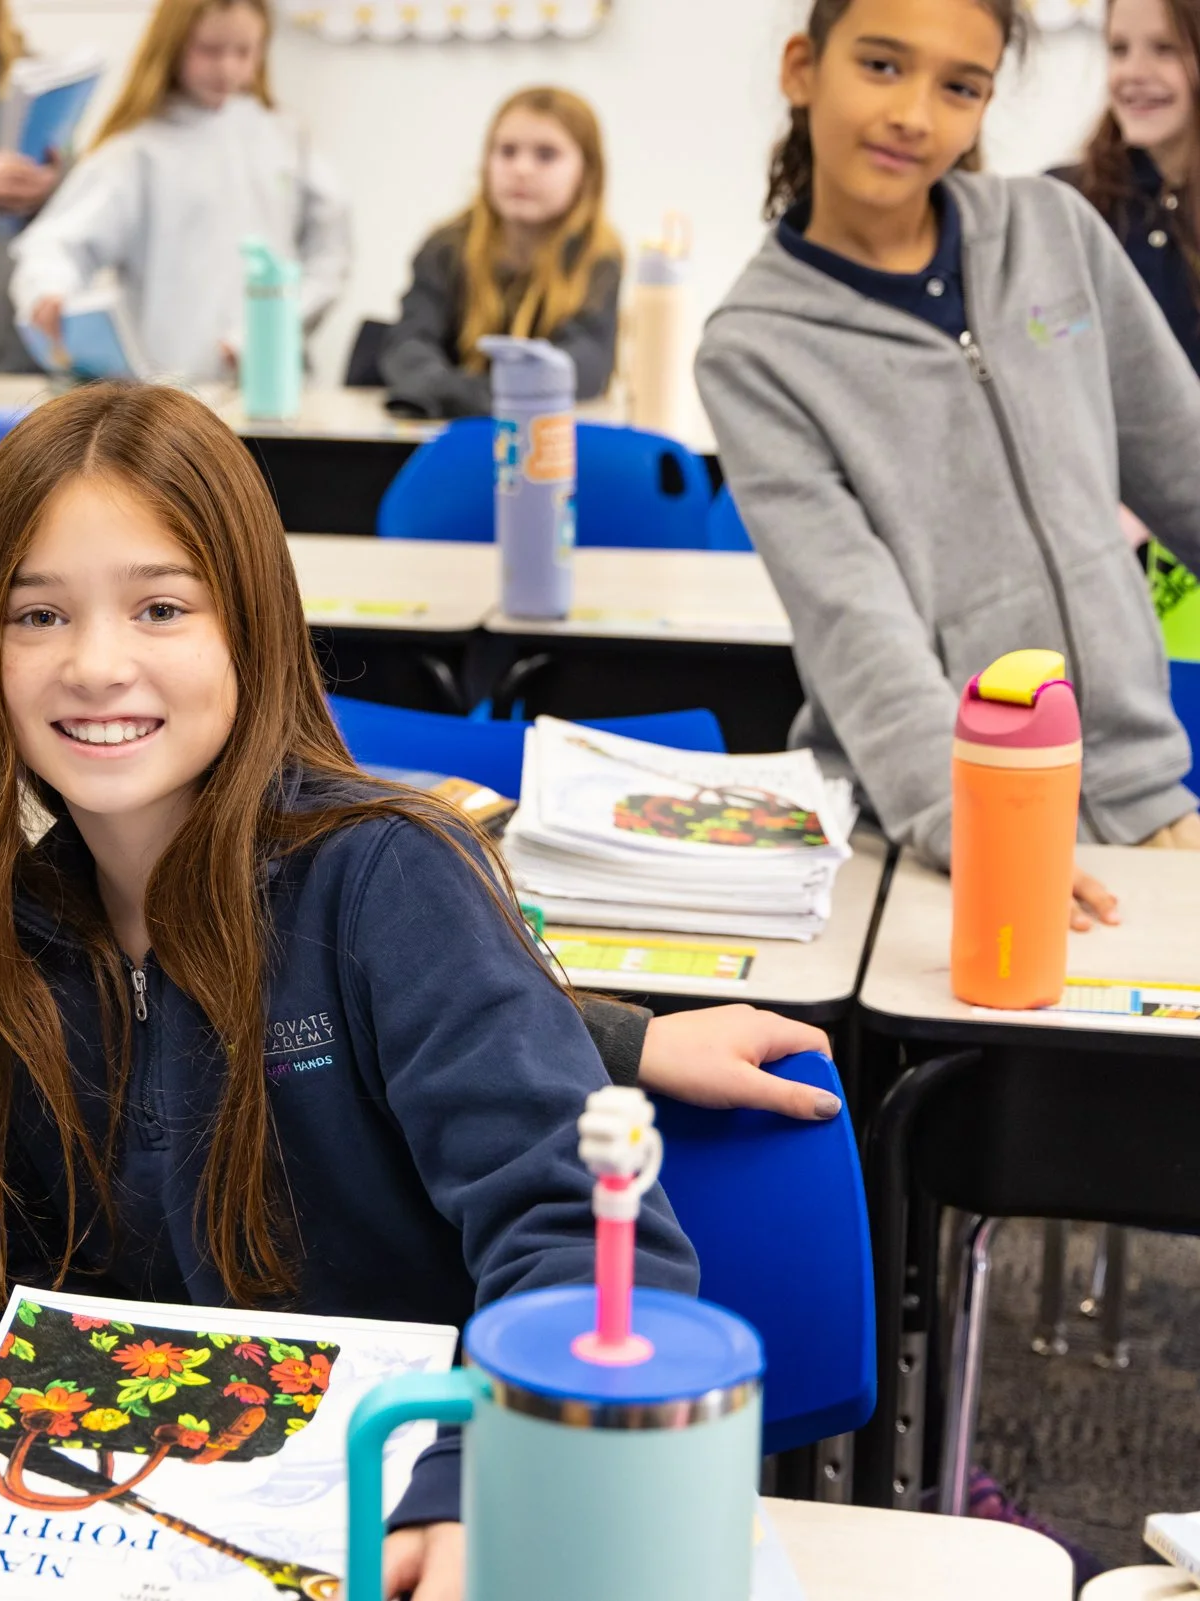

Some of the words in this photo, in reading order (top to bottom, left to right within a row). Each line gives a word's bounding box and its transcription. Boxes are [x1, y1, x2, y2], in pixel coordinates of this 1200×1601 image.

[264, 1012, 331, 1037] NOVATE
[264, 1026, 334, 1051] ADEMY
[293, 1055, 333, 1072] HANDS
